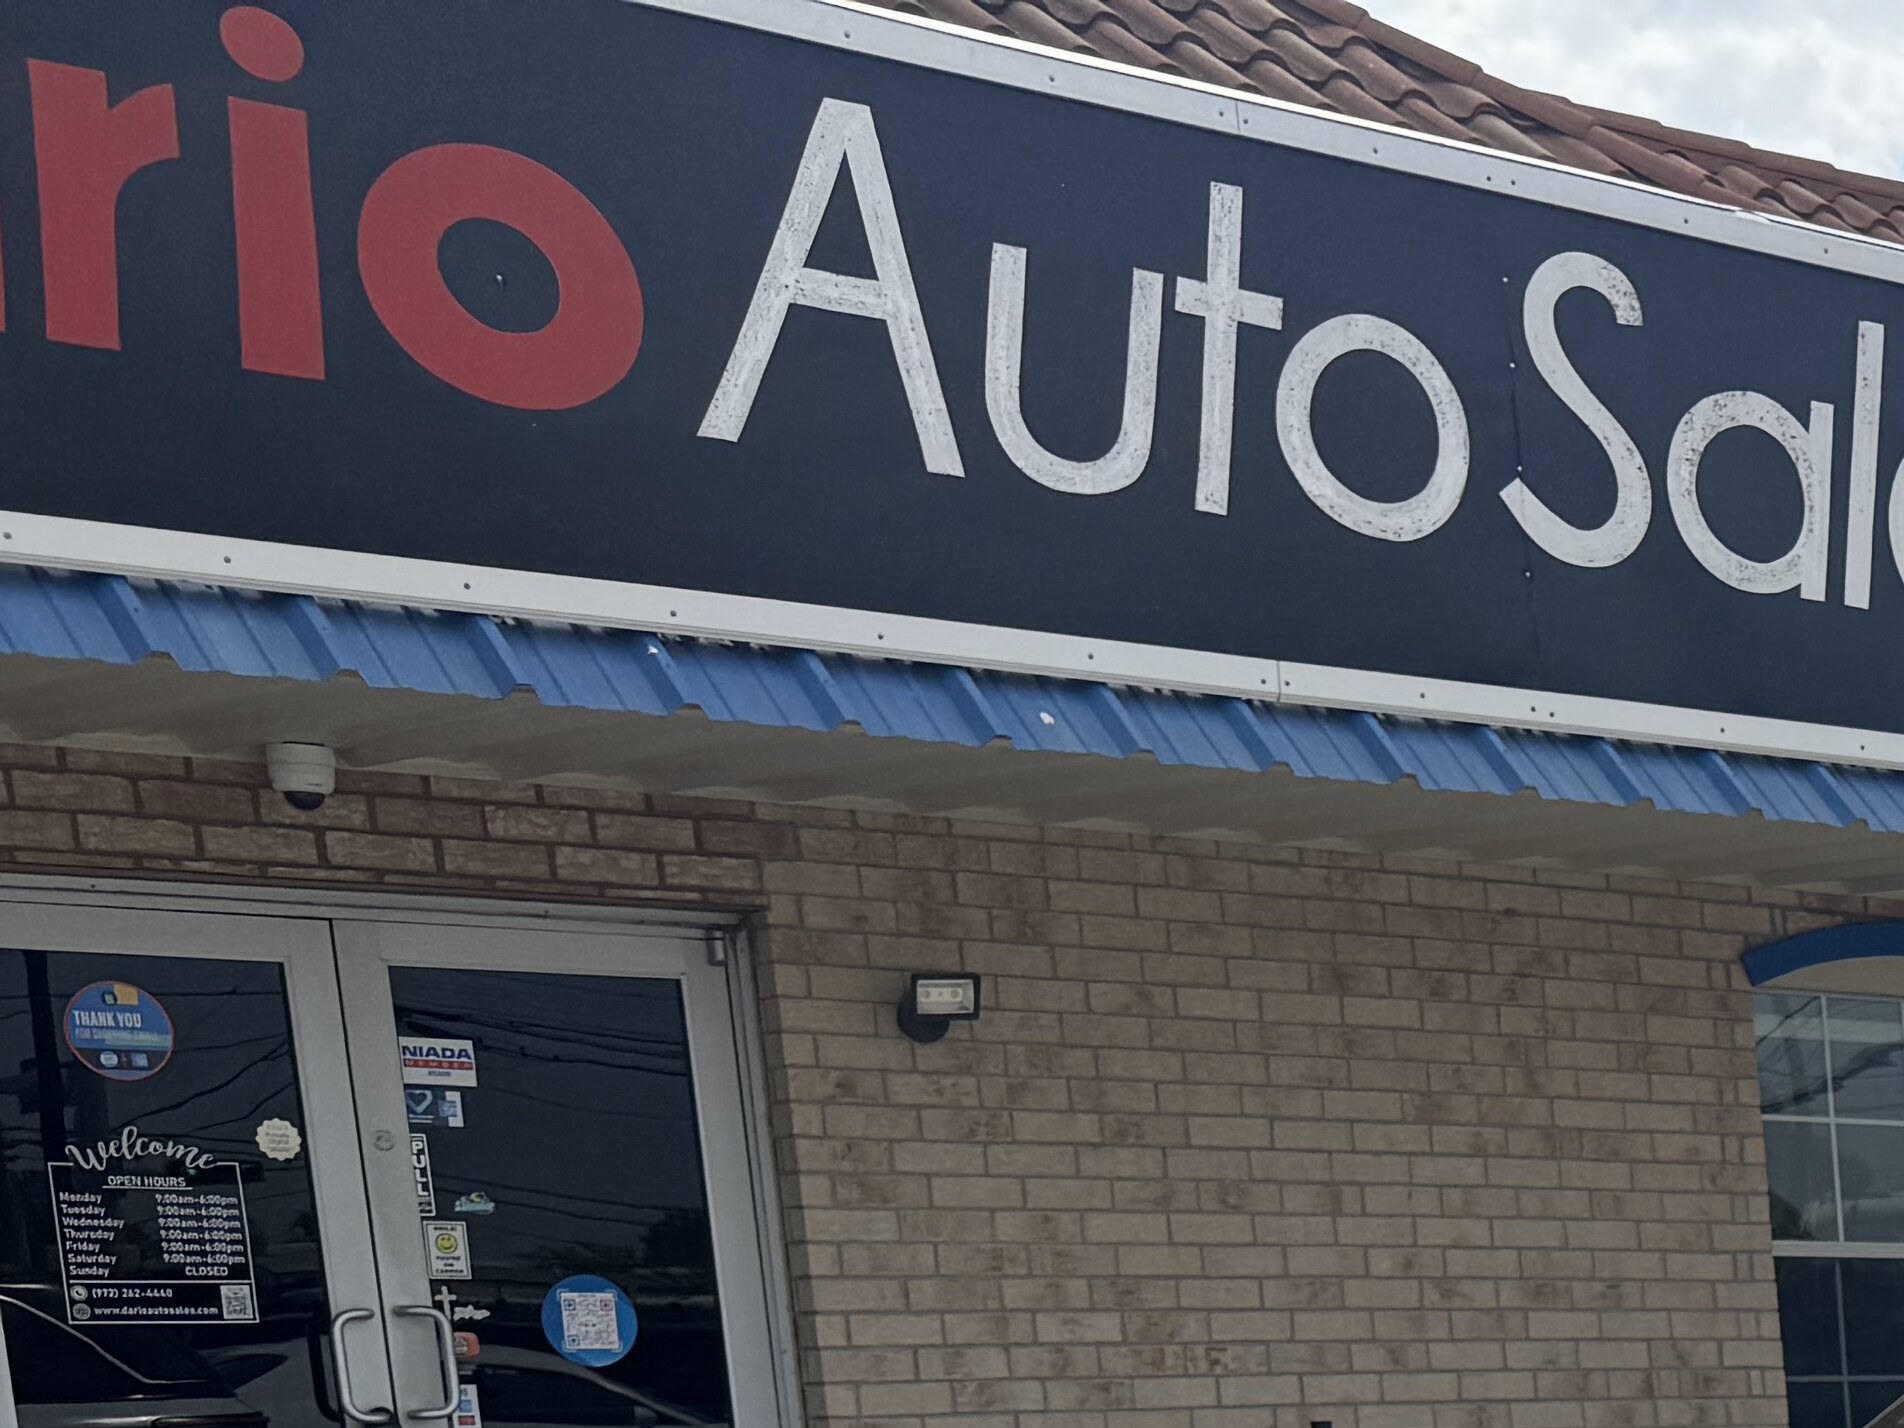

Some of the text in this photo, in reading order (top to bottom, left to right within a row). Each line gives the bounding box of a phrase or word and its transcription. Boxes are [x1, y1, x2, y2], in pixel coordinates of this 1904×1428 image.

[0, 4, 644, 411] rio
[697, 96, 1470, 542] Auto
[72, 1010, 142, 1028] THANK YOU
[402, 1045, 472, 1060] NIADA
[64, 1125, 218, 1171] Welcome
[411, 1141, 429, 1196] PULL
[107, 1175, 186, 1187] OPEN HOURS
[59, 1192, 102, 1204] Monday
[60, 1204, 106, 1216] Tuesday
[62, 1216, 125, 1229] Wednesday
[64, 1228, 115, 1241] Thursday
[66, 1241, 100, 1253] Friday
[67, 1253, 118, 1265] Saturday
[69, 1265, 229, 1277] Sunday CLOSED
